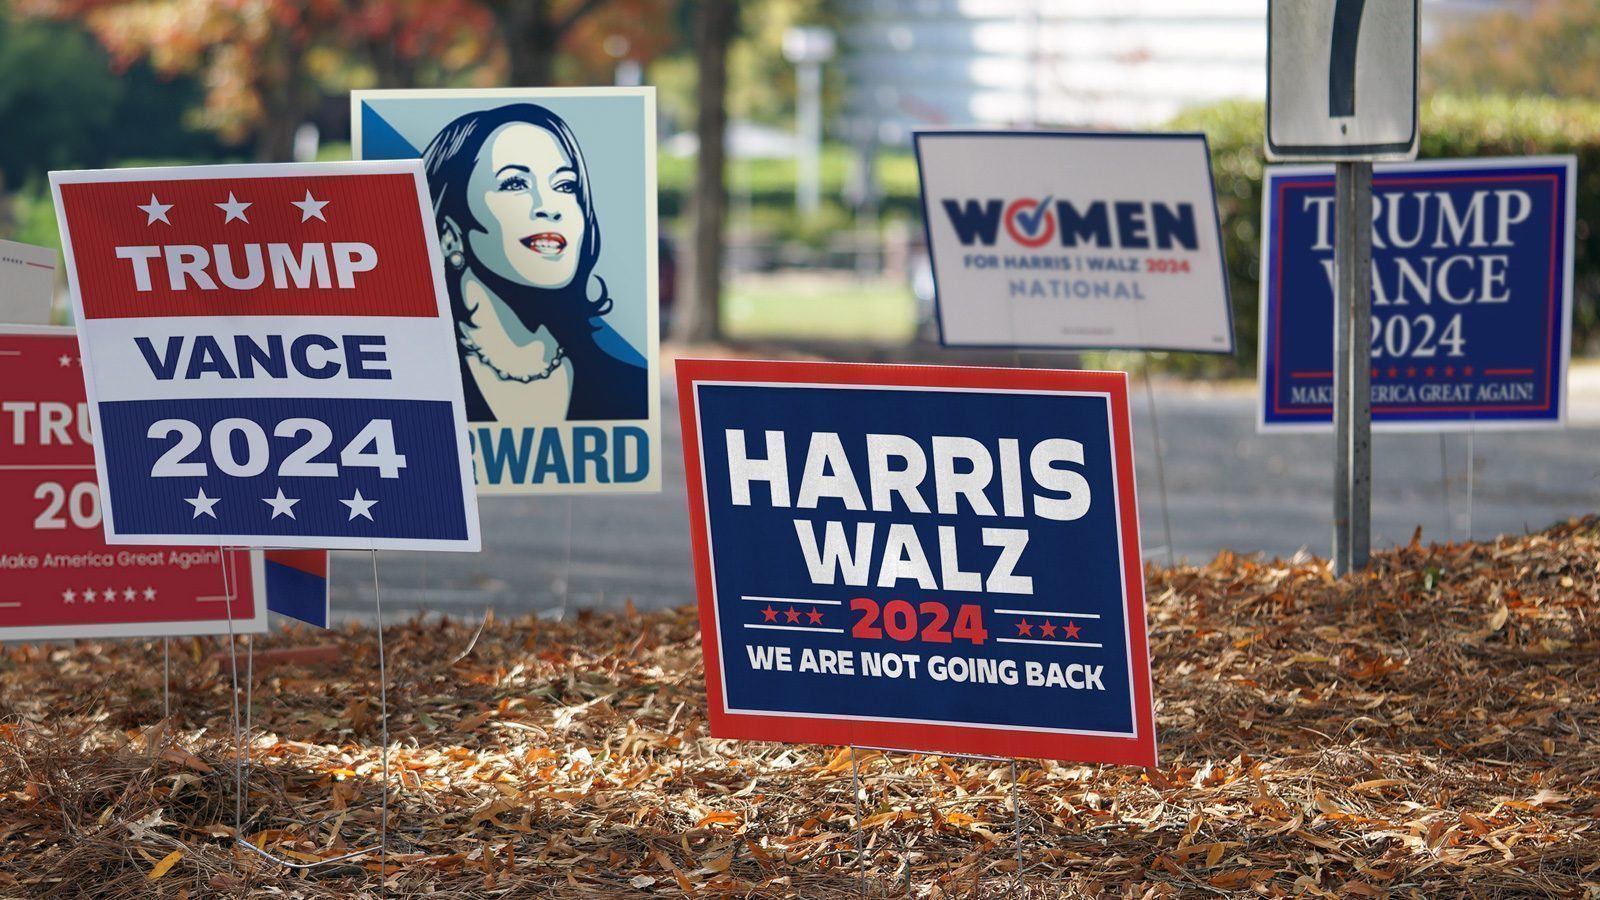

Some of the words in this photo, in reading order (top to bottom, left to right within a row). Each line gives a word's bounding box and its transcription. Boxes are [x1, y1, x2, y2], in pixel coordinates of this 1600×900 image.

[941, 196, 1199, 252] WOMEN
[115, 241, 378, 291] TRUMP
[963, 255, 999, 269] FOR
[1004, 255, 1071, 271] HARRIS
[1086, 257, 1139, 273] WALZ
[1144, 258, 1191, 273] 2024
[1009, 279, 1146, 300] NATIONAL
[134, 334, 392, 380] VANCE
[1290, 385, 1333, 404] MAK
[1419, 383, 1474, 402] GREAT
[1476, 382, 1534, 400] AGAIN!
[147, 417, 407, 478] 2024
[725, 429, 1092, 521] HARRIS
[33, 481, 102, 530] 20
[43, 552, 114, 568] America
[116, 550, 164, 567] Great
[168, 549, 220, 570] Again!
[793, 519, 1034, 595] WALZ
[850, 597, 989, 645] 2024
[746, 645, 793, 672] WE
[799, 648, 855, 676] ARE
[860, 651, 921, 680] NOT
[927, 655, 1019, 686] GOING
[1025, 661, 1106, 691] BACK
